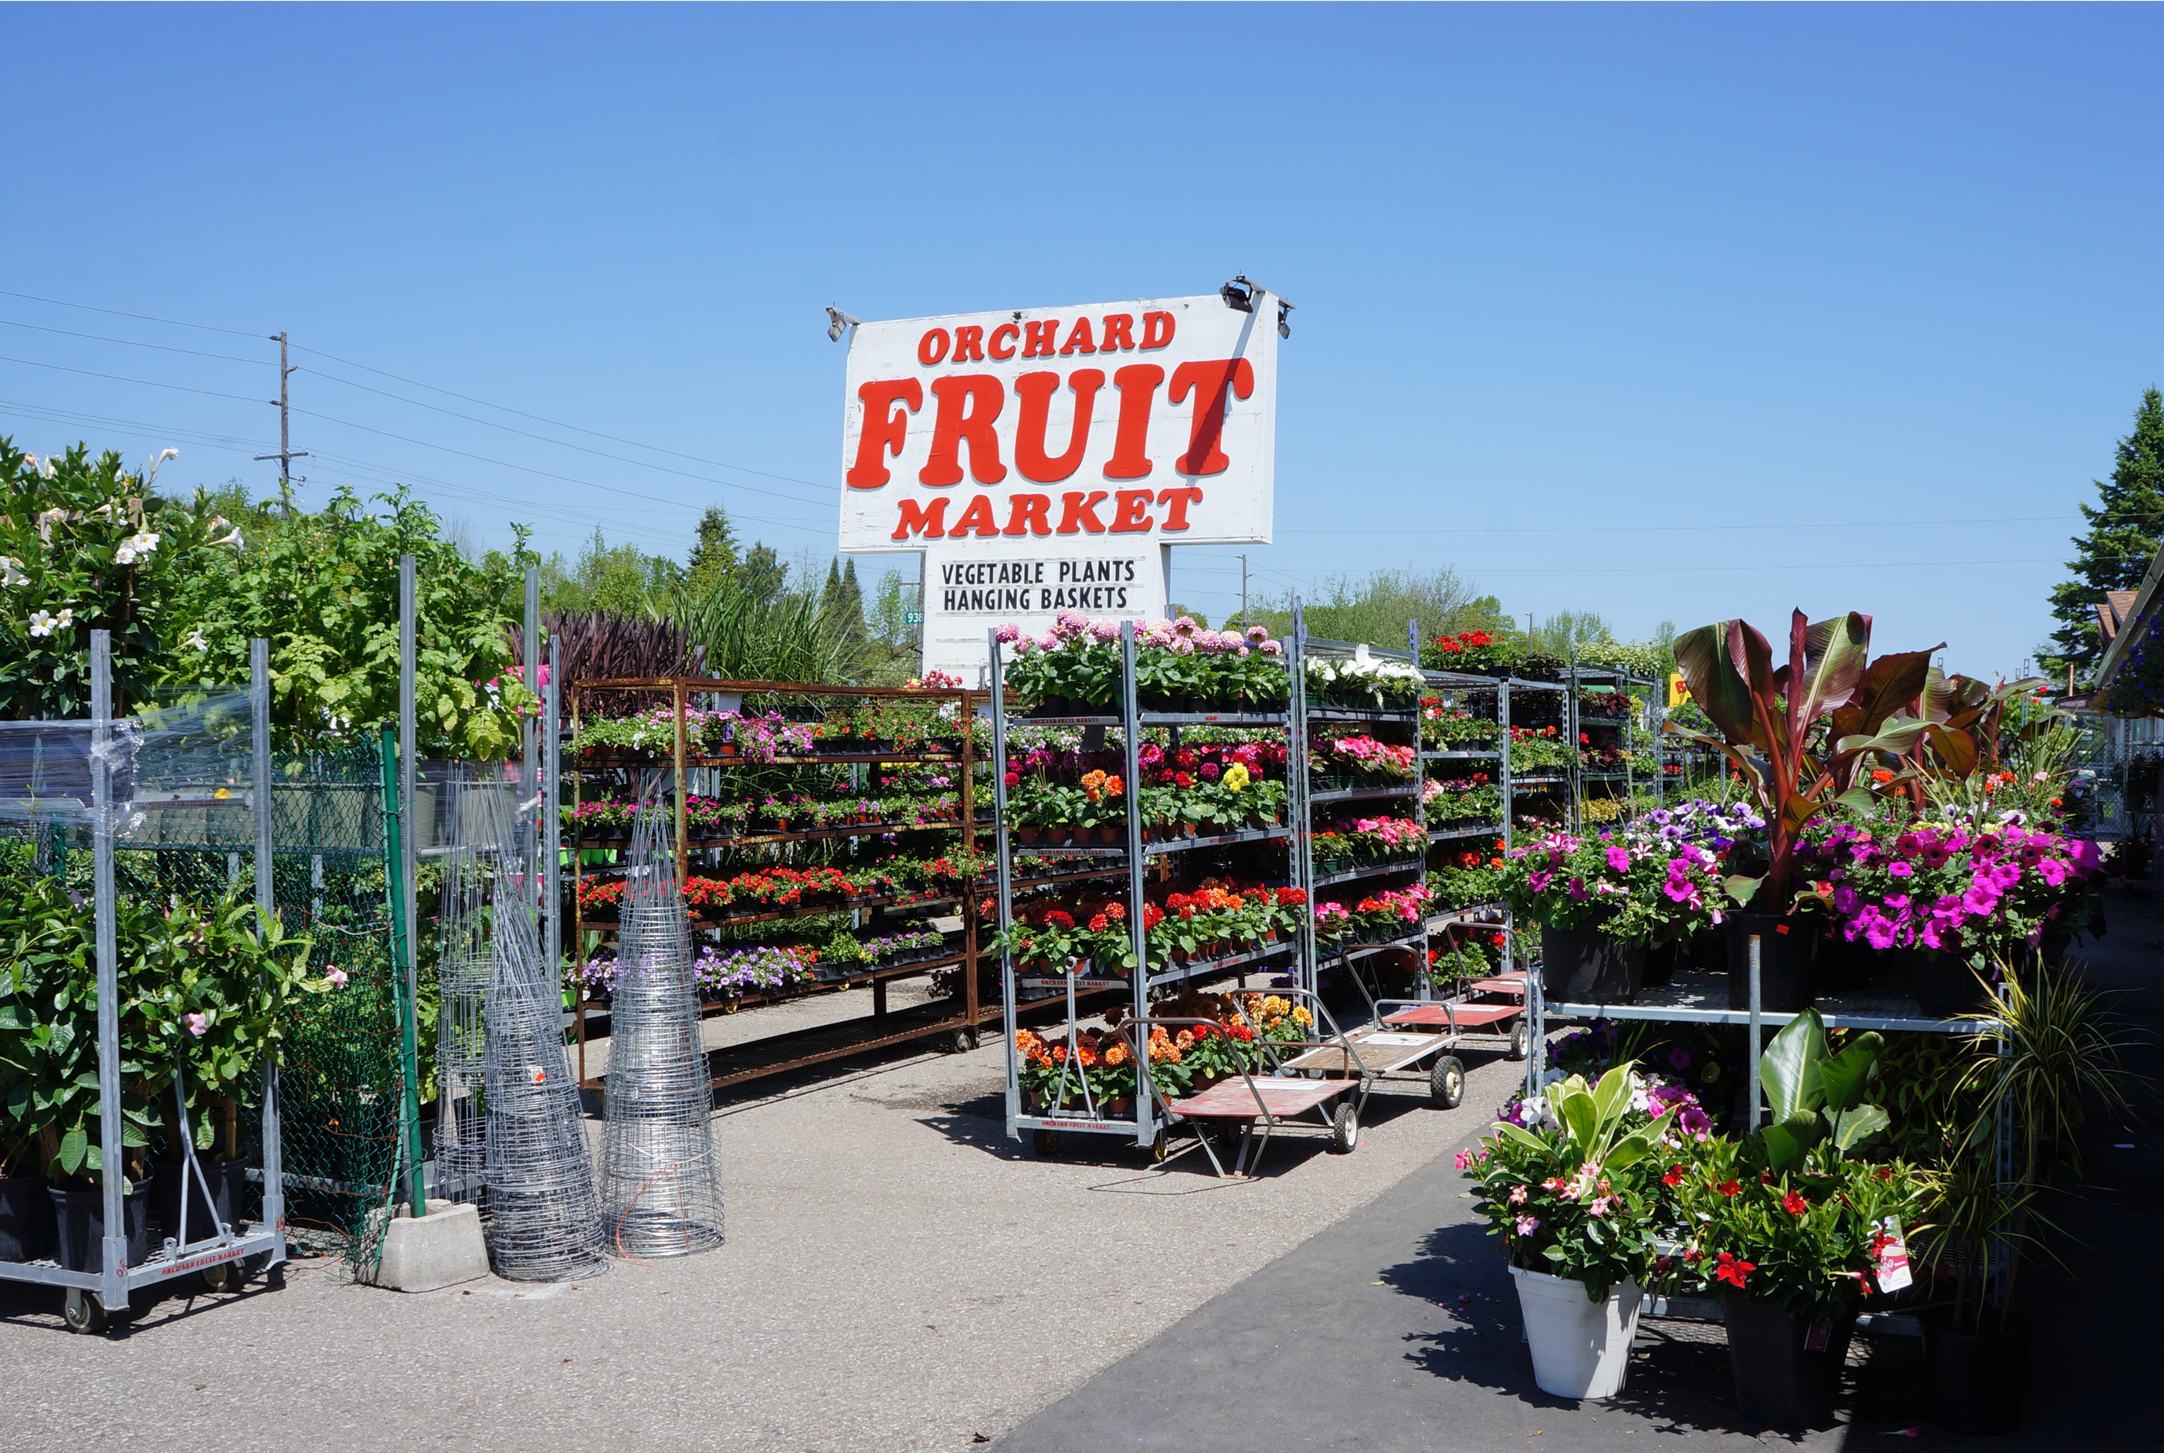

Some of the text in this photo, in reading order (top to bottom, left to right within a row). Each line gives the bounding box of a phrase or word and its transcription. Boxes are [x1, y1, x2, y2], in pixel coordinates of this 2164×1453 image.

[918, 311, 1175, 365] ORCHARD
[846, 358, 1254, 489] FRUIT
[891, 487, 1203, 540] MARKET
[942, 560, 1135, 585] VEGETABLE PLANTS
[944, 587, 1127, 611] HANGING BASKETS
[161, 1248, 244, 1275] ORCHARD FRUIT MARKET
